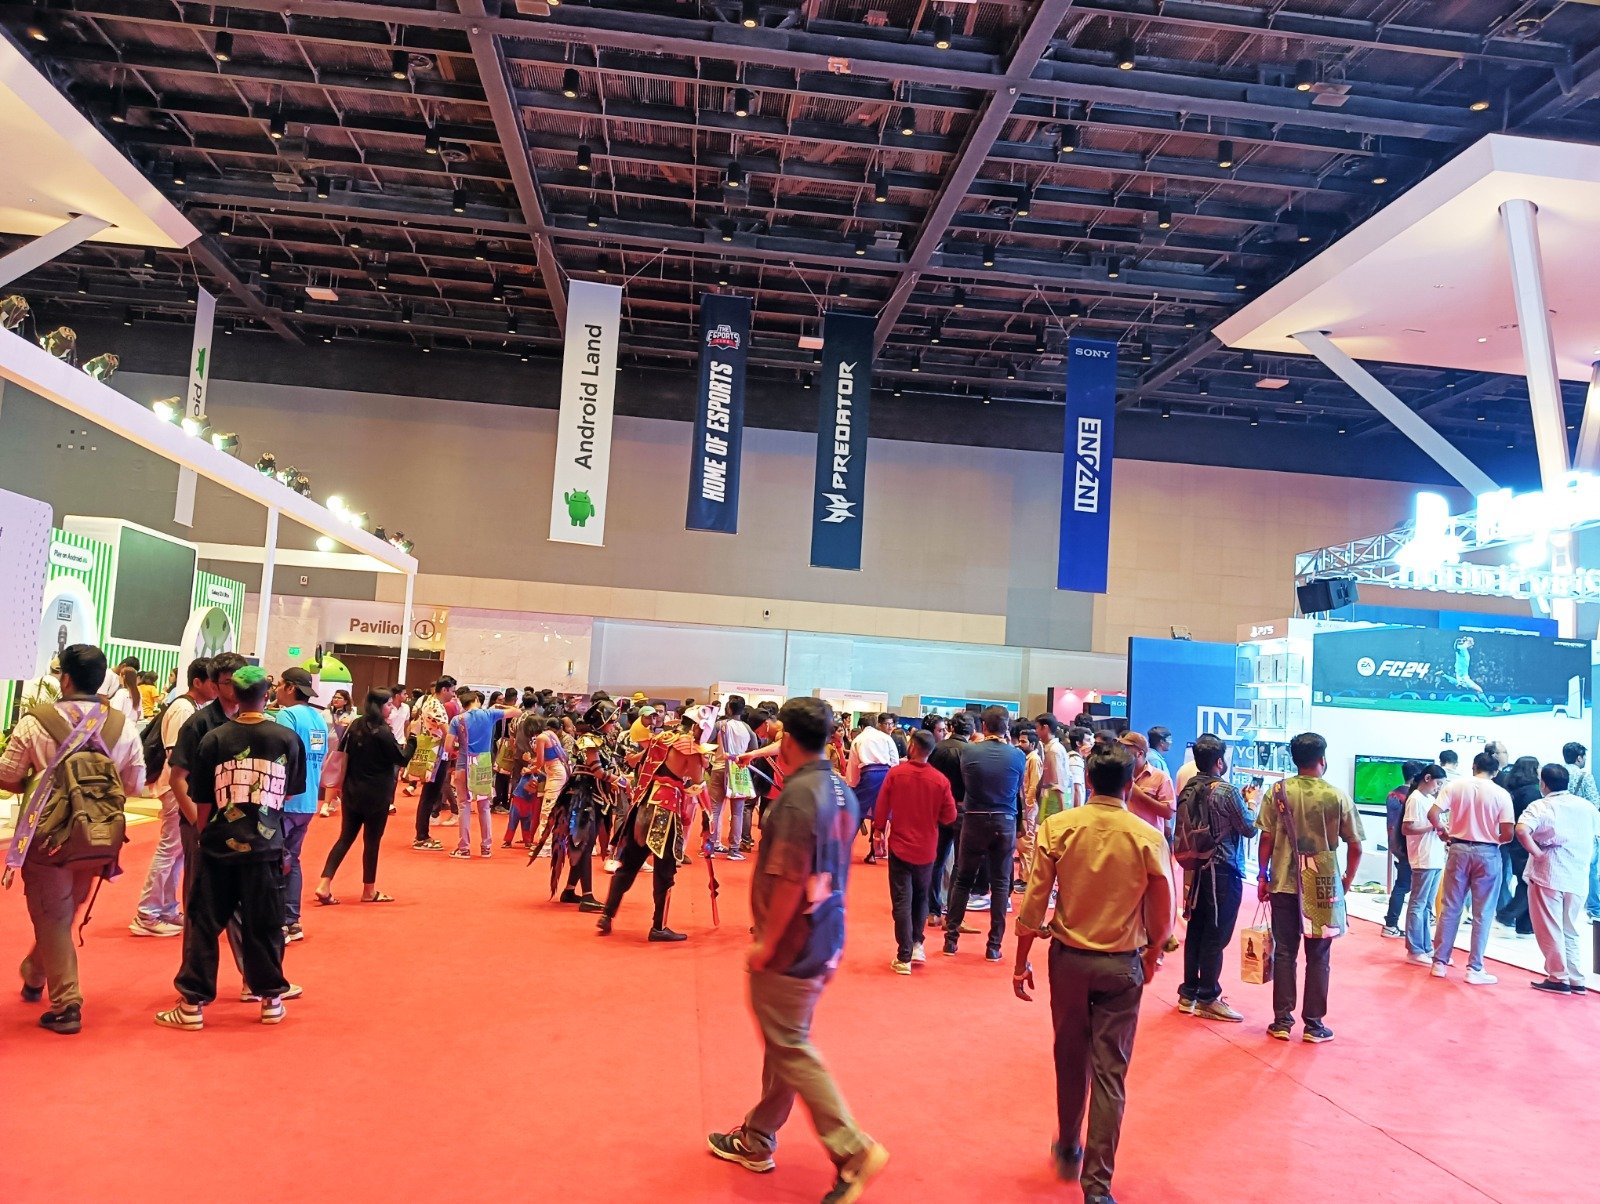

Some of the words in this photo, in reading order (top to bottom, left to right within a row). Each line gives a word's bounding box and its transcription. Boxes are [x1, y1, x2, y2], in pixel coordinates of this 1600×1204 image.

[581, 324, 602, 377] Land
[708, 331, 739, 343] ESPORTS
[1075, 347, 1110, 358] SONY
[707, 361, 732, 432] ESPORTS
[574, 382, 598, 470] Android
[705, 433, 727, 455] OF
[832, 361, 858, 489] PREDATOR
[702, 457, 726, 502] HOME
[1077, 421, 1098, 509] INZONE
[1456, 734, 1487, 744] PS5
